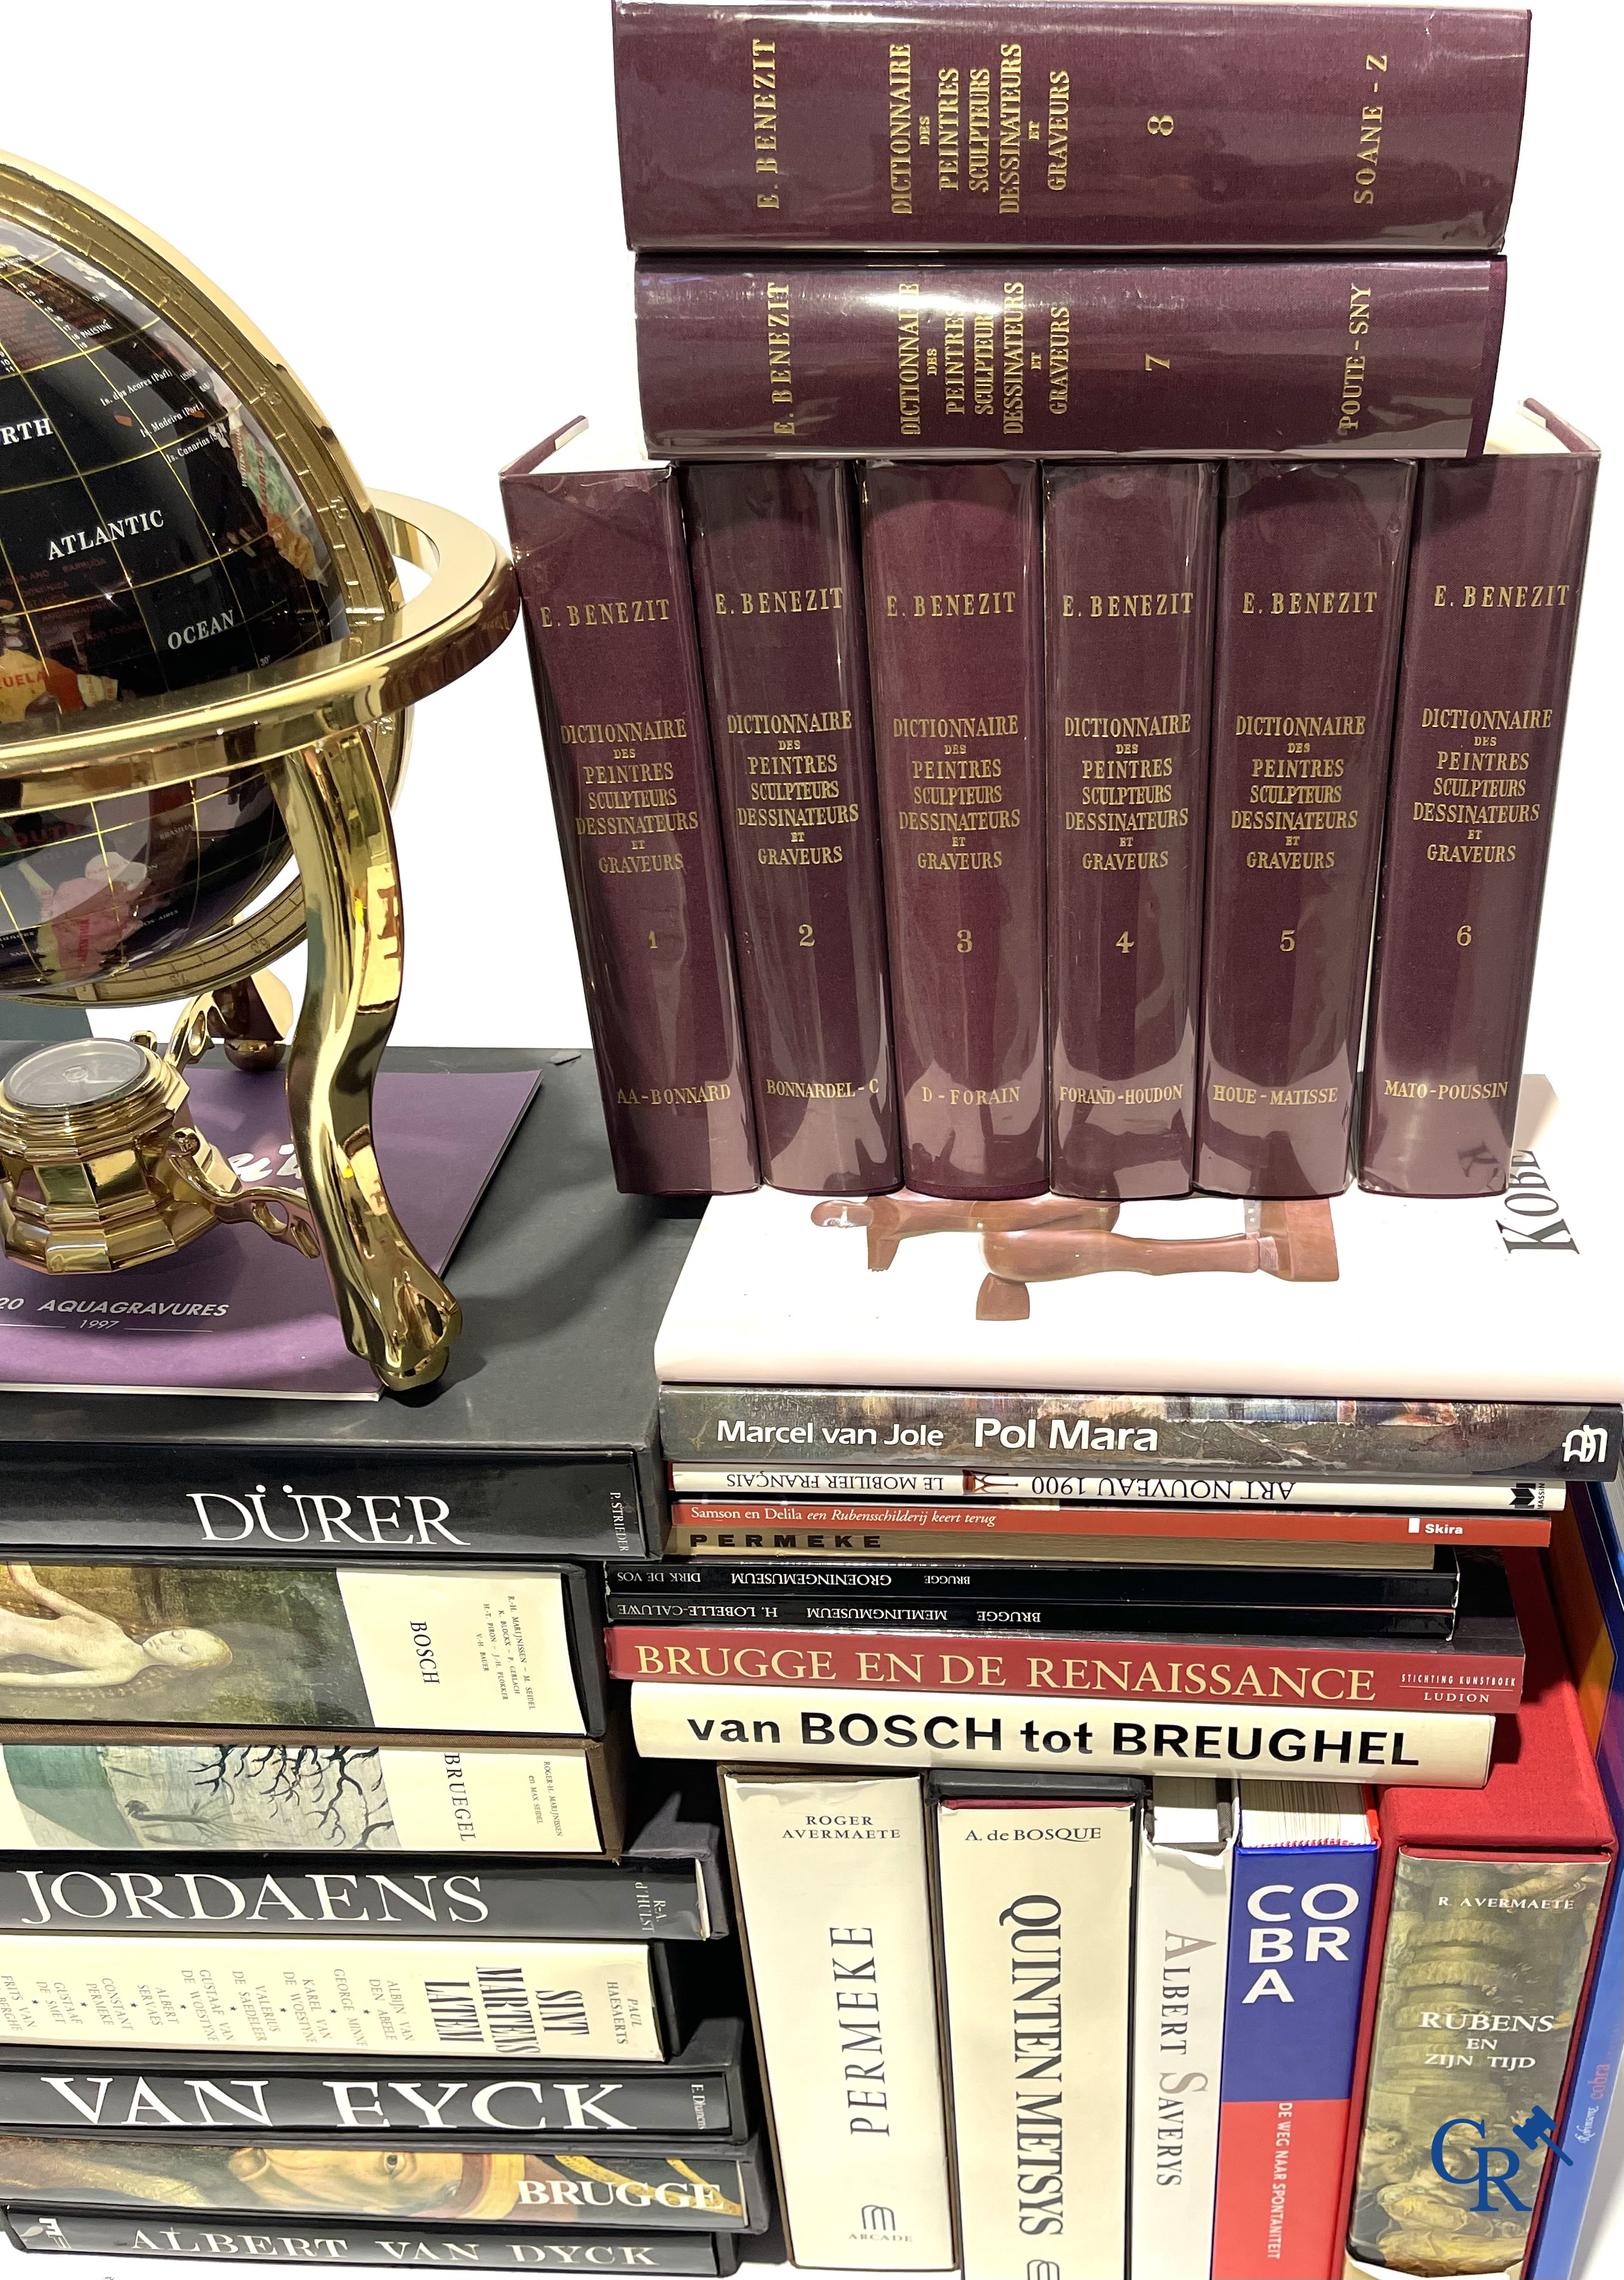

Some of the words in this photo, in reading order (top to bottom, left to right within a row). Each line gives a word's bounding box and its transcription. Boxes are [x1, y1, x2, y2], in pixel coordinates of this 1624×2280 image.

[752, 38, 779, 175] BENEZIT
[889, 42, 912, 215] DICTIONNAIRE
[919, 115, 931, 146] DES
[938, 66, 960, 191] PEINTRES
[969, 67, 991, 193] SCULPTEURS
[999, 42, 1022, 214] DESSINATEURS
[1029, 120, 1039, 140] ET
[1048, 70, 1070, 191] GRAVEURS
[1147, 114, 1174, 136] 8
[1353, 105, 1384, 205] SOANE
[757, 183, 779, 209] E.
[766, 281, 793, 405] BENEZIT
[1003, 281, 1024, 435] DESSINATEURS
[1048, 306, 1070, 415] GRAVEURS
[1144, 354, 1170, 371] 7
[773, 412, 796, 435] E.
[47, 509, 166, 561] ATLANTIC
[716, 593, 735, 615] E.
[741, 587, 844, 614] BENEZIT
[887, 595, 906, 618] E.
[914, 591, 1017, 618] BENEZIT
[1063, 594, 1082, 618] E.
[1090, 592, 1194, 618] BENEZIT
[1434, 585, 1454, 607] E.
[1462, 584, 1570, 608] BENEZIT
[540, 606, 562, 628] E.
[567, 599, 670, 627] BENEZIT
[167, 609, 235, 652] OCEAN
[561, 718, 688, 745] DICTIONNAIRE
[726, 709, 853, 735] DICTIONNAIRE
[1064, 713, 1192, 738] DICTIONNAIRE
[1421, 707, 1553, 730] DICTIONNAIRE
[798, 924, 815, 948] 2
[956, 930, 973, 953] 3
[1115, 930, 1135, 954] 4
[1280, 930, 1296, 952] 5
[1455, 925, 1473, 947] 6
[37, 1299, 230, 1318] AQUAGRAVURES
[80, 1319, 120, 1329] 1997
[717, 1418, 814, 1445] Marcel
[821, 1425, 877, 1446] van
[883, 1421, 945, 1448] Jole
[974, 1416, 1037, 1449] Pol
[1048, 1418, 1158, 1452] Mara
[726, 1473, 821, 1491] FRANÇAIS
[826, 1474, 917, 1492] MOBILIER
[924, 1476, 945, 1492] LE
[1031, 1476, 1086, 1497] 1900
[1096, 1476, 1234, 1499] NOUVEAU
[1243, 1481, 1296, 1501] ART
[610, 1492, 621, 1500] P.
[1536, 1483, 1546, 1510] MASSIN
[186, 1485, 471, 1547] DÜRER
[611, 1502, 629, 1552] STRIEDER
[691, 1507, 741, 1520] Samson
[744, 1510, 760, 1520] en
[764, 1507, 803, 1521] Delila
[807, 1512, 827, 1521] een
[831, 1509, 928, 1526] Rubensschilderij
[931, 1511, 962, 1524] keert
[964, 1512, 996, 1527] terug
[1425, 1523, 1464, 1536] Skira
[690, 1533, 882, 1549] PERMEKE
[617, 1572, 643, 1582] VOS
[646, 1572, 664, 1582] DE
[670, 1573, 701, 1583] DIRK
[731, 1572, 892, 1586] GROENINGEMUSEUM
[924, 1574, 971, 1585] BRUGGE
[617, 1604, 757, 1617] LOBELLE-CALUWE
[761, 1607, 778, 1617] H.
[806, 1607, 948, 1622] MEMLINGMUSEUM
[976, 1610, 1041, 1623] BRUGGE
[409, 1620, 442, 1686] BOSCH
[500, 1621, 511, 1646] BLOCKX
[509, 1666, 521, 1695] GERLACH
[511, 1616, 528, 1663] MARIJNISSEN
[525, 1686, 536, 1710] SEIDEL
[635, 1645, 837, 1681] BRUGGE
[854, 1652, 925, 1685] EN
[939, 1655, 1007, 1687] DE
[1026, 1657, 1377, 1701] RENAISSANCE
[1401, 1673, 1455, 1686] STICHTING
[1459, 1674, 1516, 1688] KUNSTBOEK
[1424, 1691, 1490, 1704] LUDION
[686, 1717, 781, 1743] van
[800, 1711, 1002, 1751] BOSCH
[1020, 1719, 1093, 1755] tot
[1113, 1721, 1420, 1767] BREUGHEL
[444, 1752, 476, 1843] BRUEGEL
[530, 1786, 539, 1802] MAX
[533, 1803, 543, 1824] SEIDEL
[549, 1795, 563, 1837] MARIJNISSEN
[805, 1815, 874, 1826] ROGER
[781, 1828, 902, 1840] AVERMAETE
[964, 1829, 983, 1842] A.
[987, 1830, 1010, 1841] de
[1012, 1826, 1102, 1843] BOSQUE
[16, 1870, 489, 1925] JORDAENS
[1460, 1897, 1575, 1910] AVERMAETE
[999, 1894, 1063, 2083] QUINTEN
[1242, 1968, 1295, 2004] A
[85, 1983, 115, 2026] PERMEKE
[101, 1977, 134, 2031] CONSTANT
[255, 1984, 282, 2033] VALERIUS
[333, 1968, 355, 2012] GEORGE
[347, 2017, 369, 2047] MINNE
[387, 1979, 407, 2015] ALBIJN
[399, 2021, 416, 2041] VAN
[424, 1980, 485, 2043] LATEM
[476, 1965, 542, 2053] MARTENS
[535, 1990, 590, 2036] SINT
[607, 1981, 629, 2046] HAESAERTS
[626, 1997, 643, 2028] PAUL
[829, 1926, 891, 2137] PERMEKE
[1418, 2011, 1555, 2033] RUBENS
[1466, 2038, 1497, 2051] EN
[1425, 2053, 1473, 2067] ZIJN
[1486, 2055, 1536, 2071] TIJD
[1587, 2063, 1611, 2101] cobra
[40, 2076, 273, 2128] VAN
[322, 2080, 638, 2131] EYCK
[1278, 2102, 1293, 2119] DE
[1275, 2121, 1292, 2148] WEG
[1015, 2091, 1064, 2236] METSYS
[1273, 2150, 1289, 2181] NAAR
[518, 2179, 726, 2212] BRUGGE
[1267, 2183, 1287, 2260] SPONTANITEIT
[132, 2226, 349, 2258] ALBERT
[375, 2241, 480, 2261] VAN
[511, 2244, 659, 2266] DYCK
[848, 2232, 913, 2243] ARCADE
